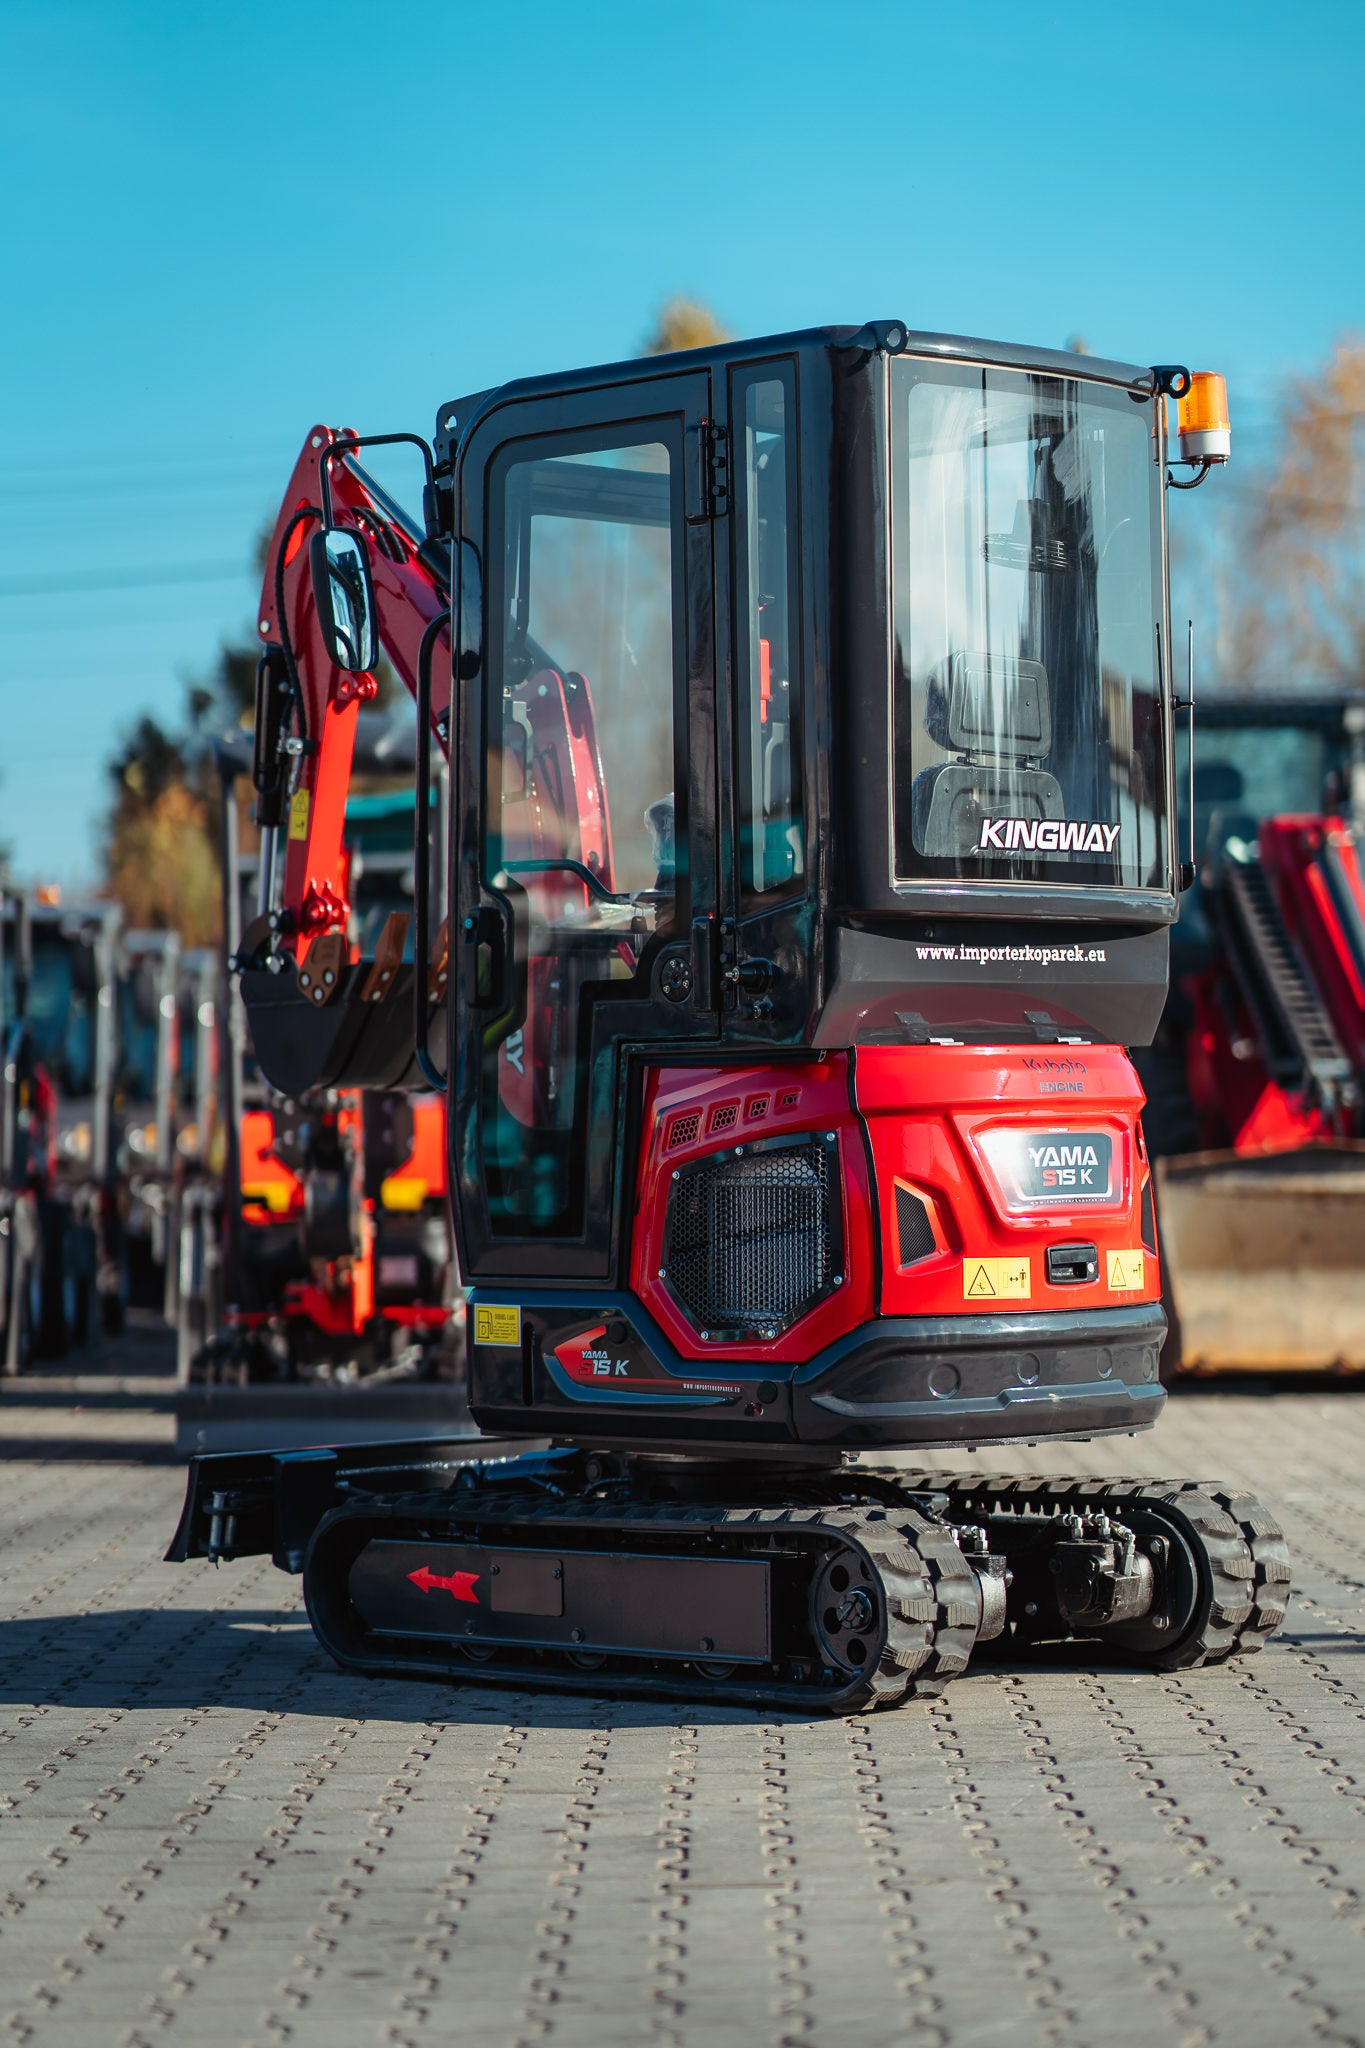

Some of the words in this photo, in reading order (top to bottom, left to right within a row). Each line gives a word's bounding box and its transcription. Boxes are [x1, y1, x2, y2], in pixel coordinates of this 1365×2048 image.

[979, 818, 1121, 853] KINGWAY
[915, 943, 1107, 966] www.importerkoparek.eu
[1022, 1057, 1087, 1075] Kubota
[1040, 1081, 1084, 1093] ENGINE
[1028, 1145, 1099, 1168] YAMA
[1042, 1168, 1077, 1187] S15
[1081, 1168, 1094, 1185] K
[581, 1350, 609, 1360] YAMA
[579, 1359, 612, 1376] S15
[614, 1359, 631, 1376] K
